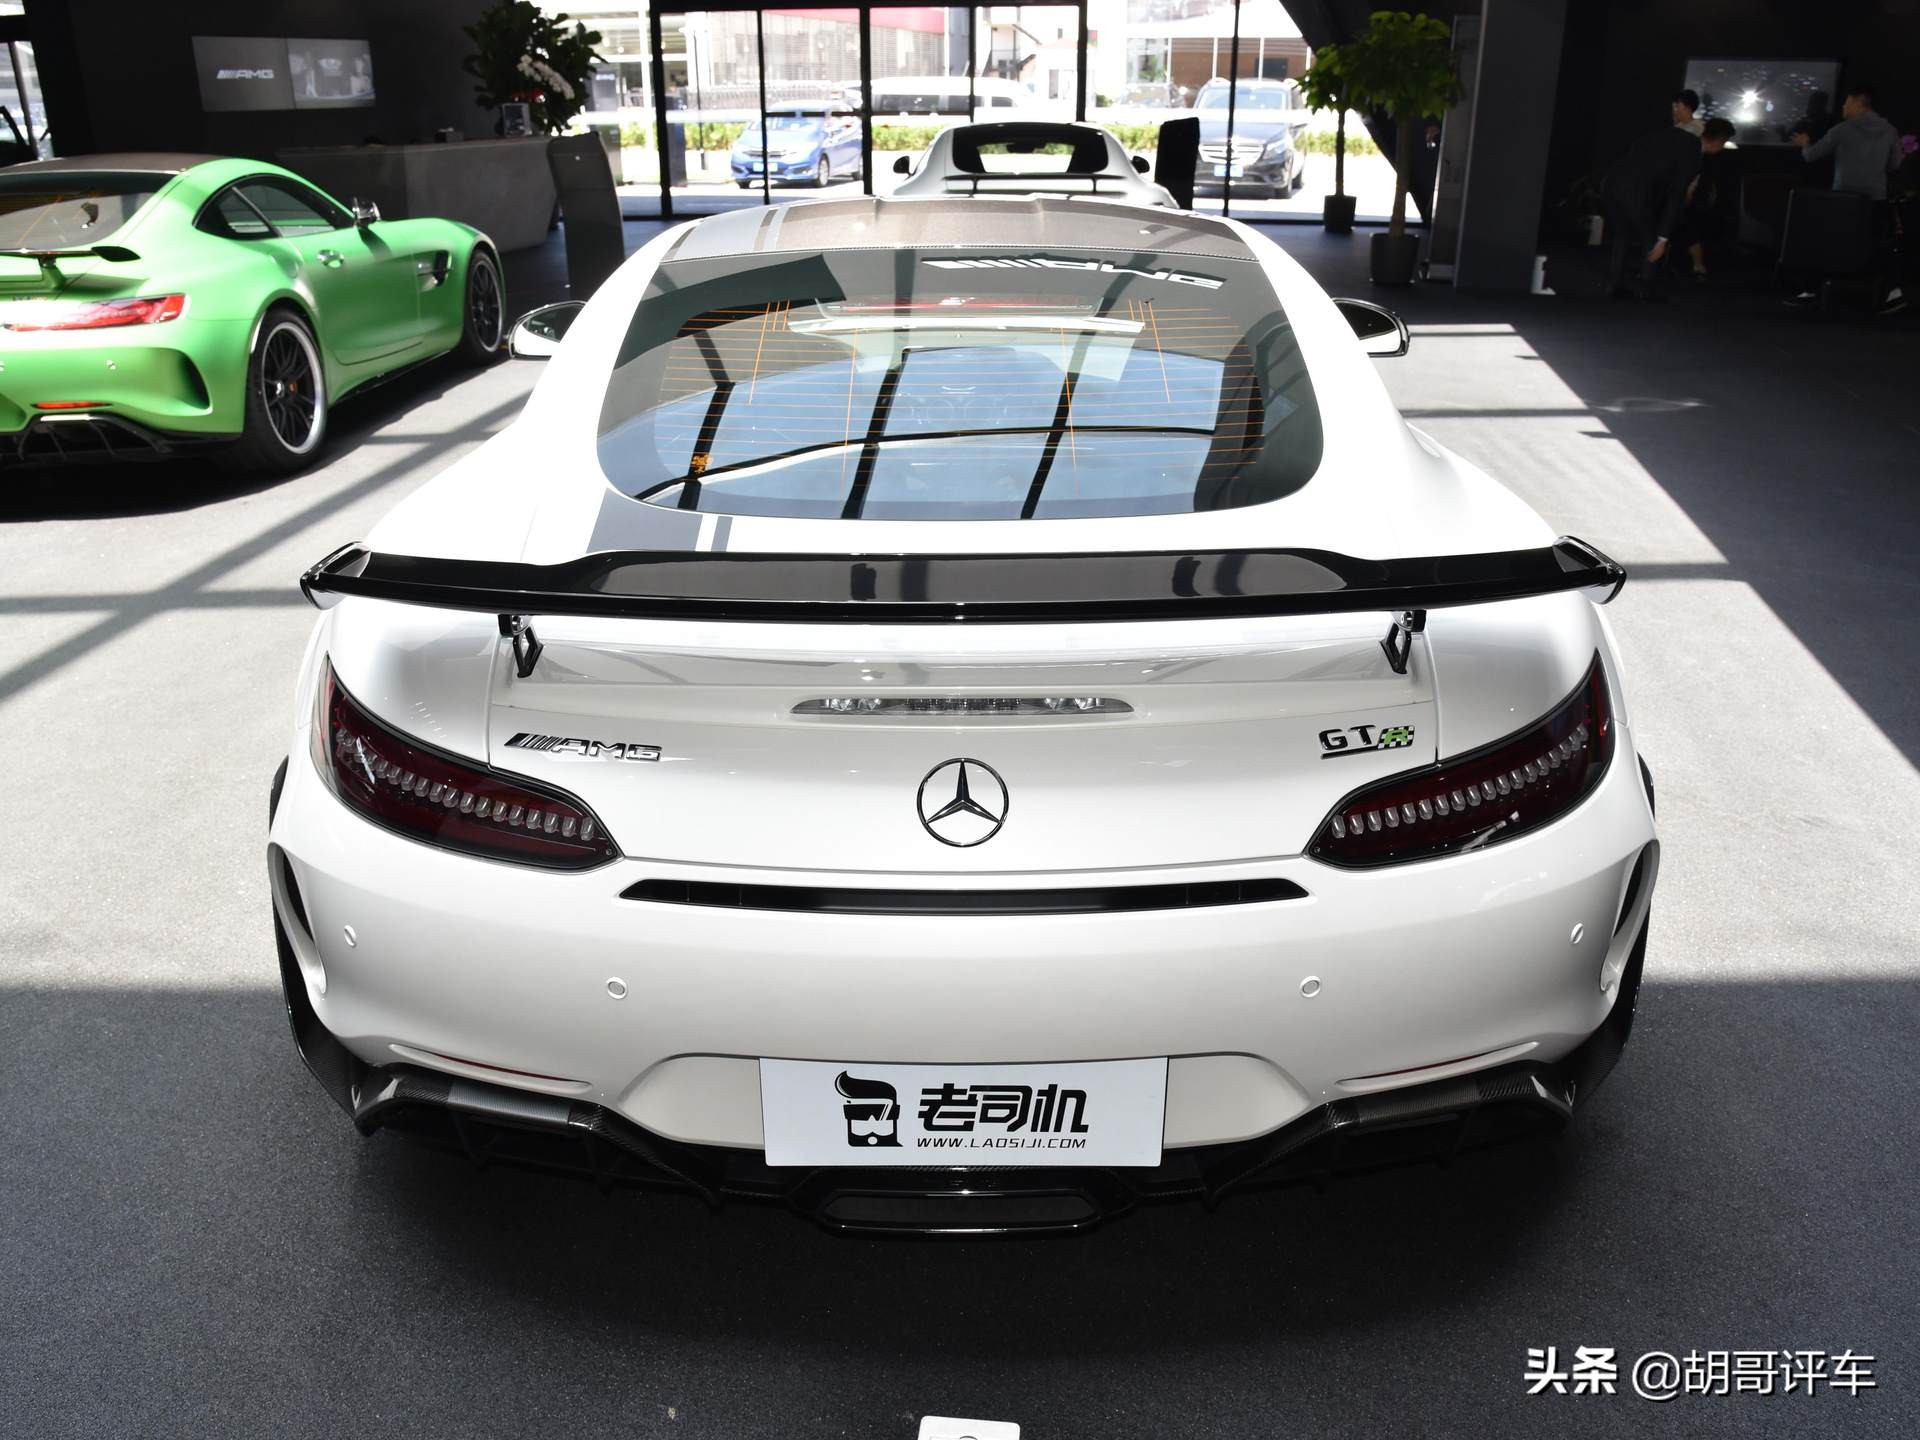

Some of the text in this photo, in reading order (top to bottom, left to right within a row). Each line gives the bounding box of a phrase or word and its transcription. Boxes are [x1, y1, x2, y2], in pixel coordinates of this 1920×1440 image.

[236, 69, 274, 79] AMG
[550, 737, 663, 762] AMG
[918, 1083, 1089, 1133] 老司机
[917, 1138, 1087, 1149] WWW.LAOSIJI.COM
